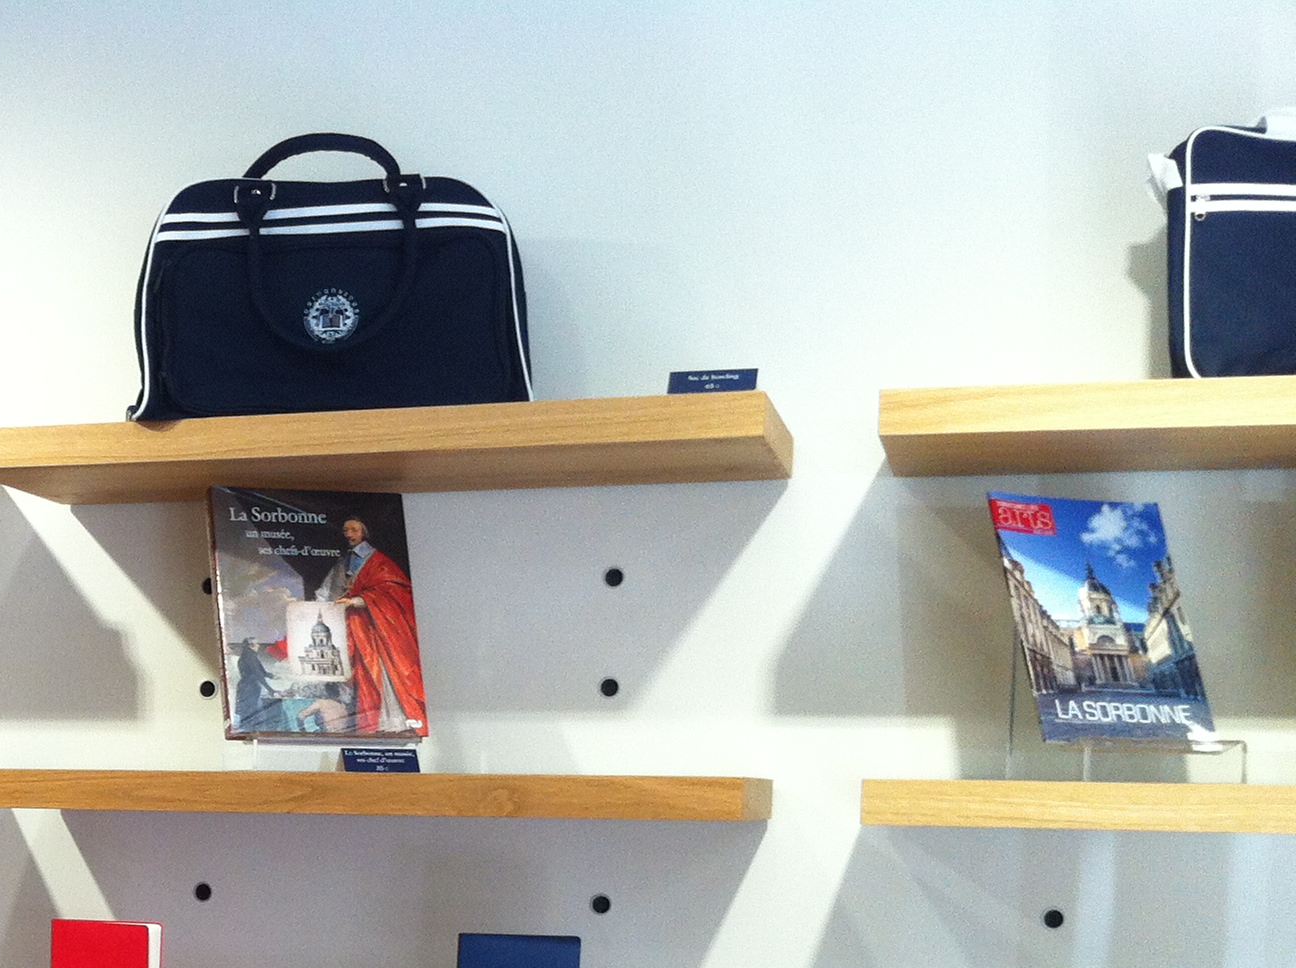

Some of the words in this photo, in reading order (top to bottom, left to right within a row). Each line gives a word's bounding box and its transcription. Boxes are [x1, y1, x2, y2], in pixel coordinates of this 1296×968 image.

[229, 506, 249, 522] La
[251, 506, 328, 524] Sorbonne
[245, 529, 259, 538] un
[1054, 699, 1083, 720] LA
[1082, 701, 1191, 724] SORBONNE
